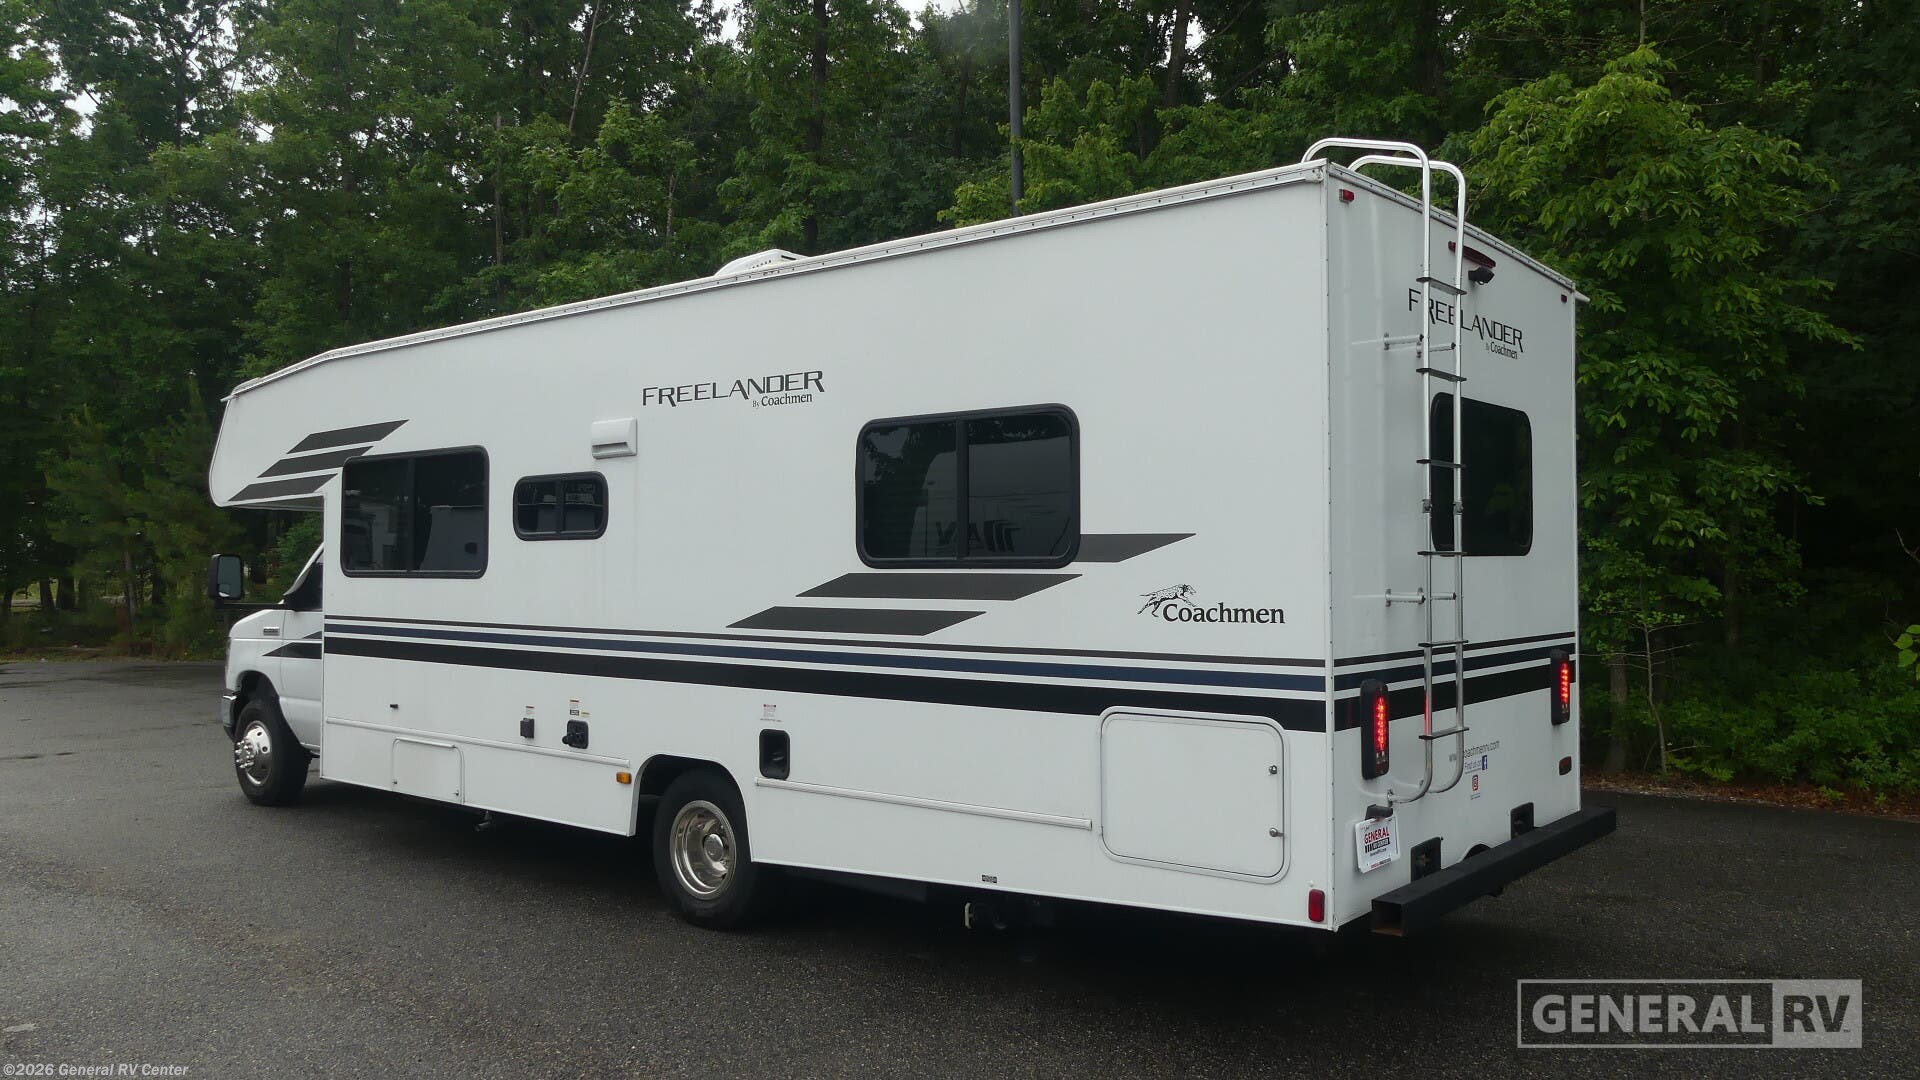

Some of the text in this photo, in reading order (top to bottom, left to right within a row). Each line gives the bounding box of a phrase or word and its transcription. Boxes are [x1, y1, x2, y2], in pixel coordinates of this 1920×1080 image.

[1408, 288, 1523, 353] FREELANDER
[1490, 341, 1518, 360] Coachmen
[642, 370, 825, 408] FREELANDER
[752, 393, 813, 410] By Coachmen
[1162, 602, 1286, 624] Coachmen
[1364, 826, 1390, 845] GENERAL
